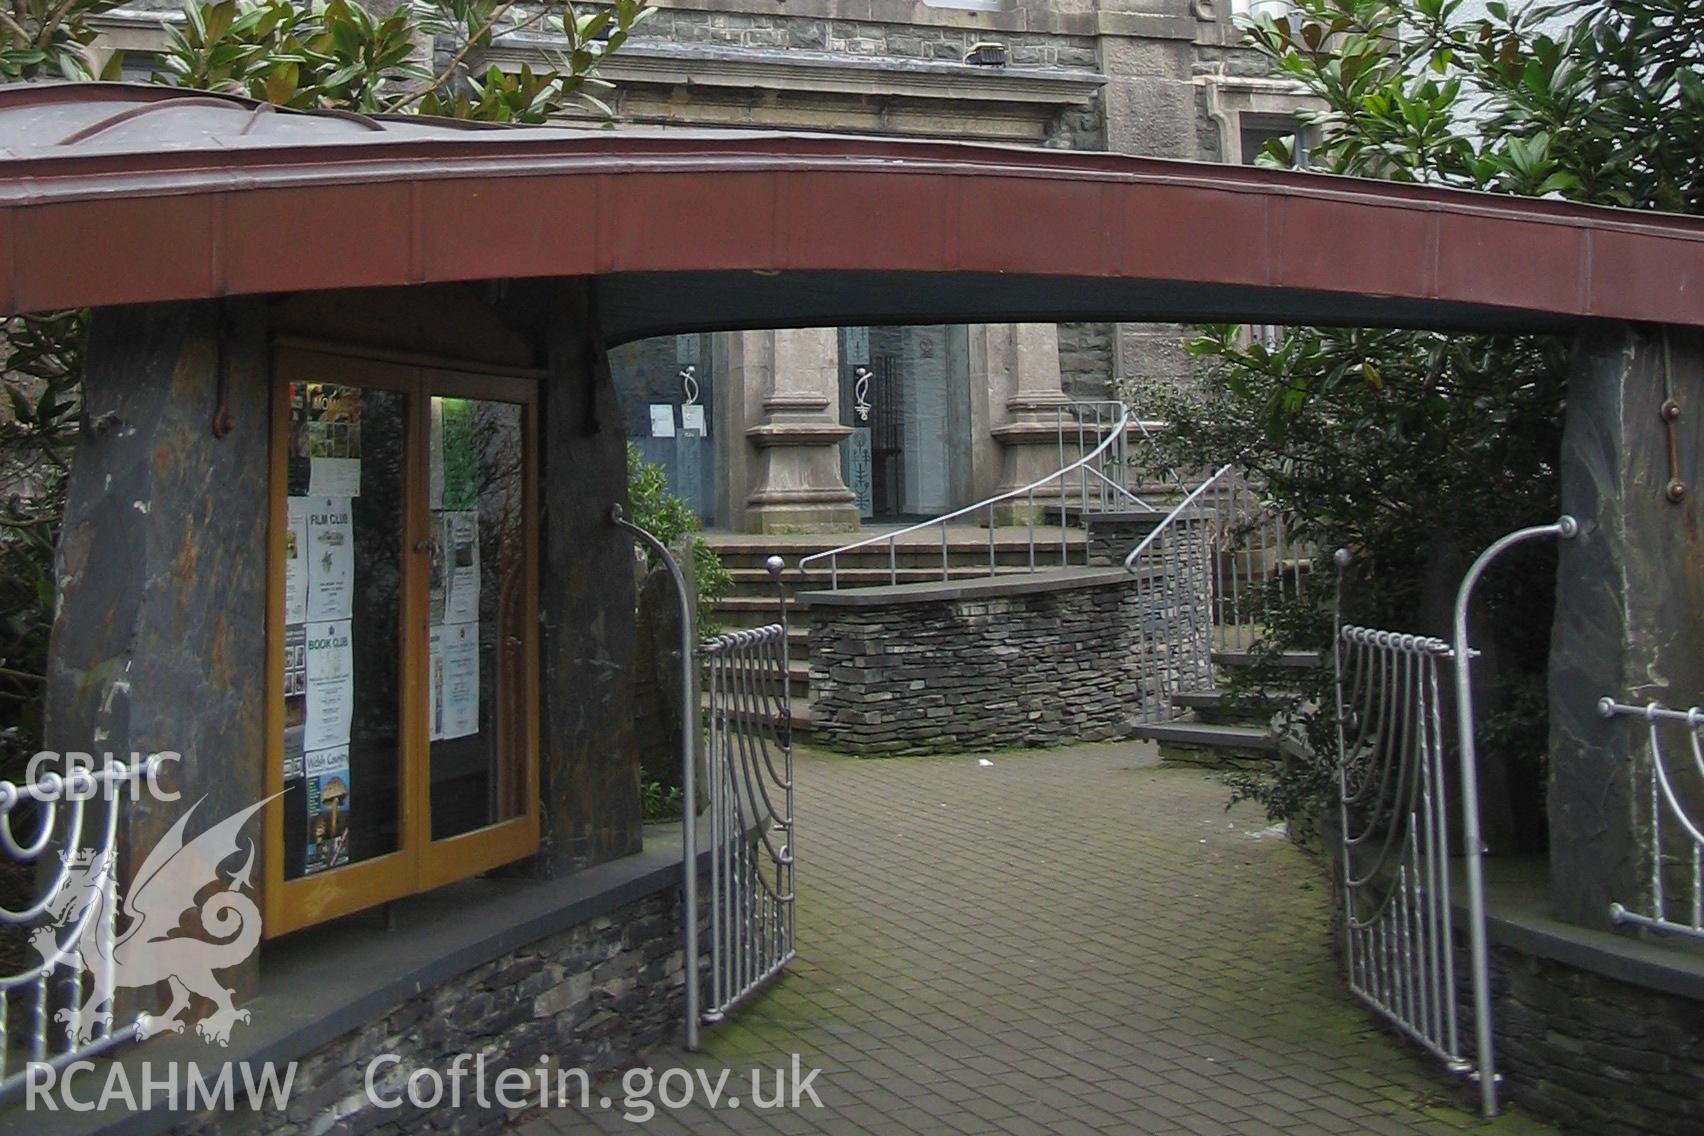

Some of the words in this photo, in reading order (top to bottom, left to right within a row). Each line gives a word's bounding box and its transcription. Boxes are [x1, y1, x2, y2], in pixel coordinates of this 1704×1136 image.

[310, 514, 328, 525] FILM
[329, 513, 348, 524] CLUB
[309, 638, 331, 650] BOOK
[333, 637, 348, 648] CLUB
